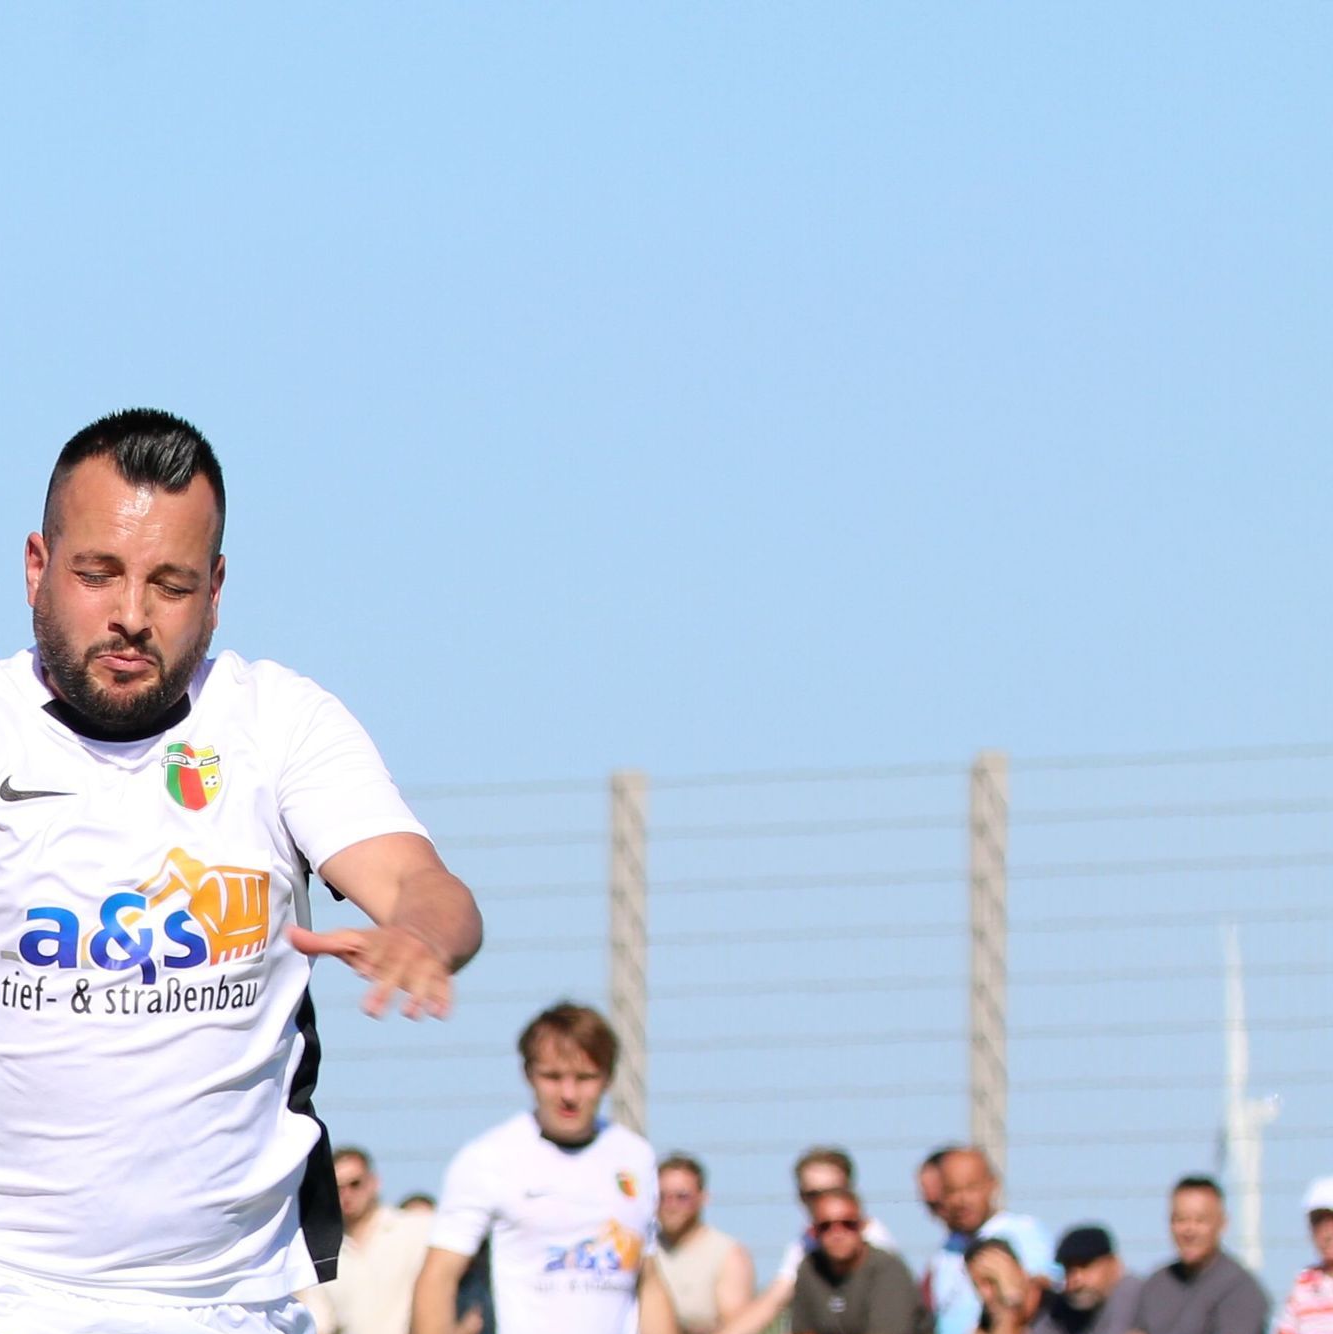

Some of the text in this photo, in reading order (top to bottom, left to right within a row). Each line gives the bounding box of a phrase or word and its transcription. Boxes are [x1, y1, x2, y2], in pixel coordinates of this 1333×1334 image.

[19, 892, 209, 985] a&s
[0, 971, 259, 1015] tief- & straßenbau
